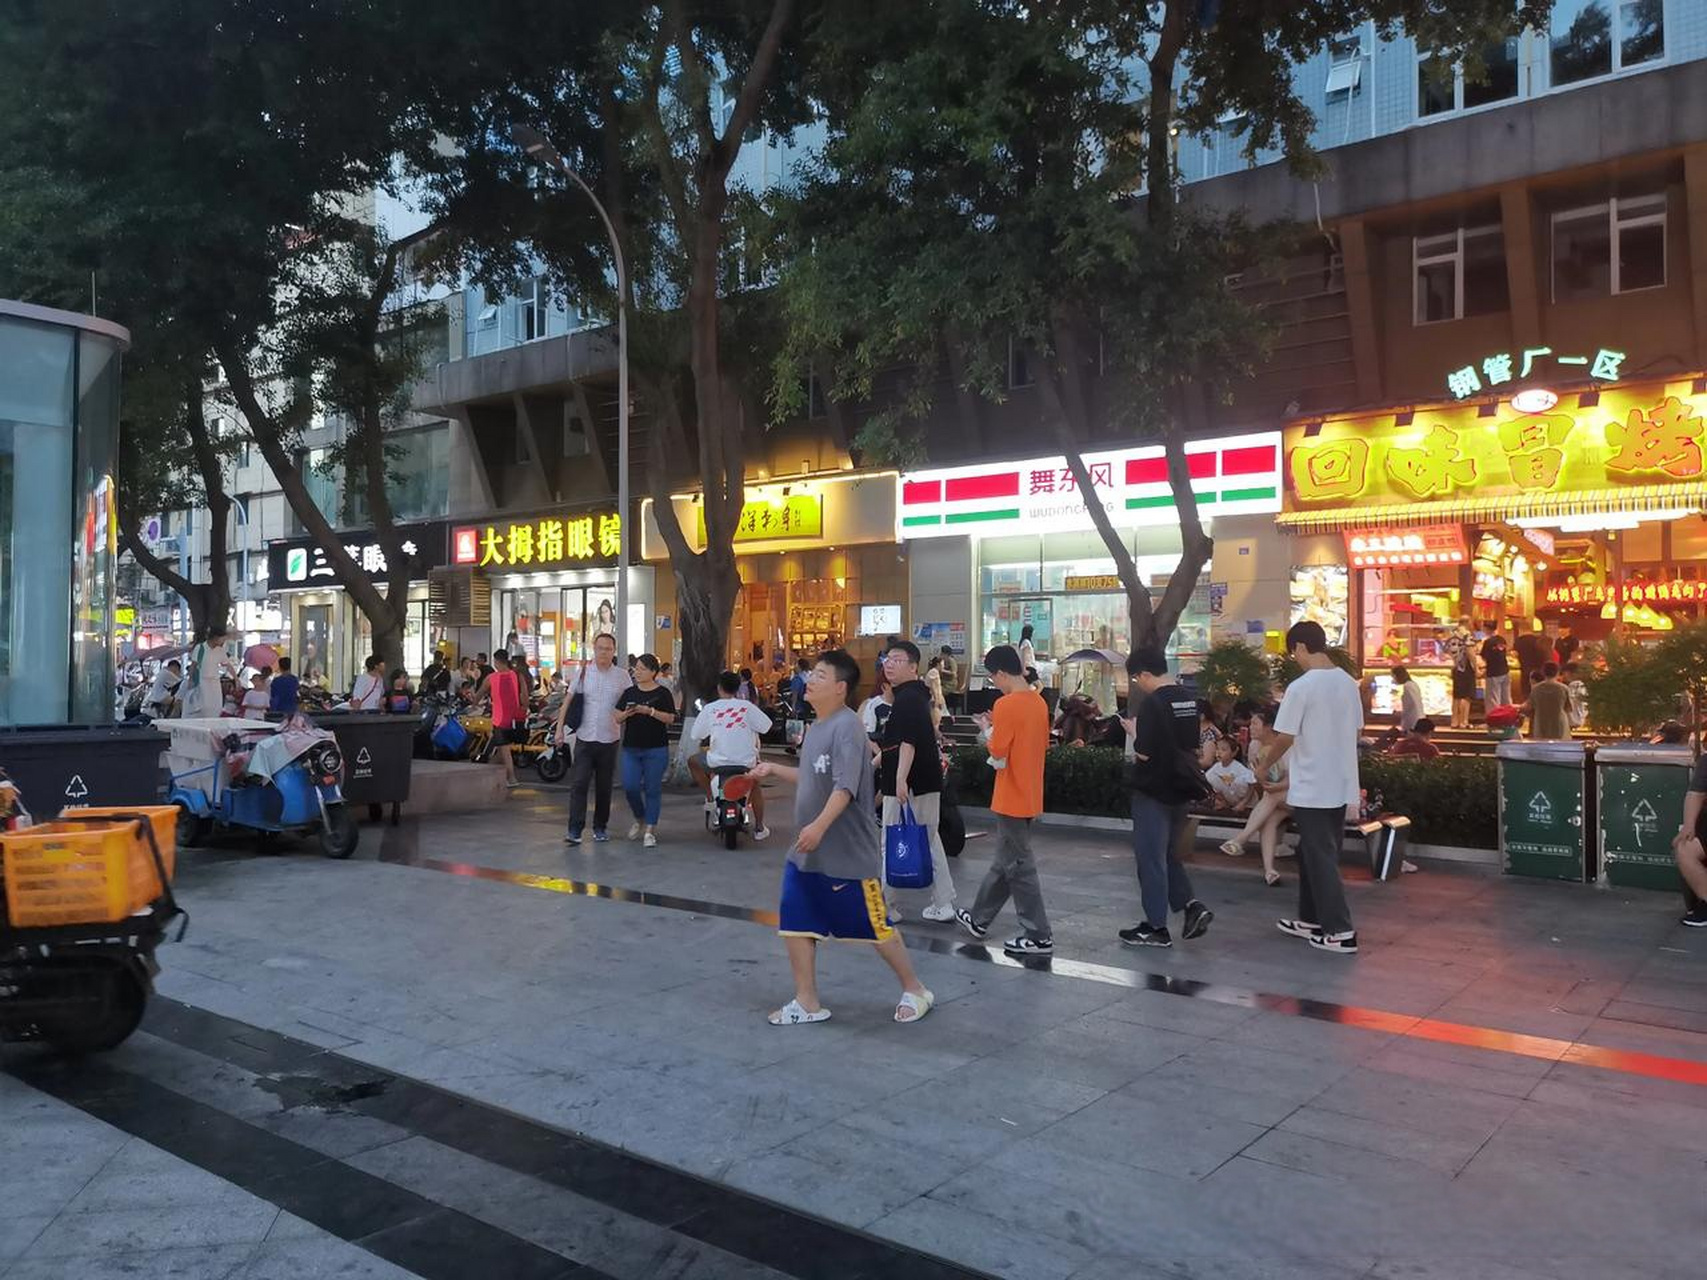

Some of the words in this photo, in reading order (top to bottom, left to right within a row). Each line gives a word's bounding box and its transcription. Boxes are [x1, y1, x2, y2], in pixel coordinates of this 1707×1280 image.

[1447, 346, 1627, 400] 钢管厂一区
[479, 513, 622, 567] 大拇指眼镜
